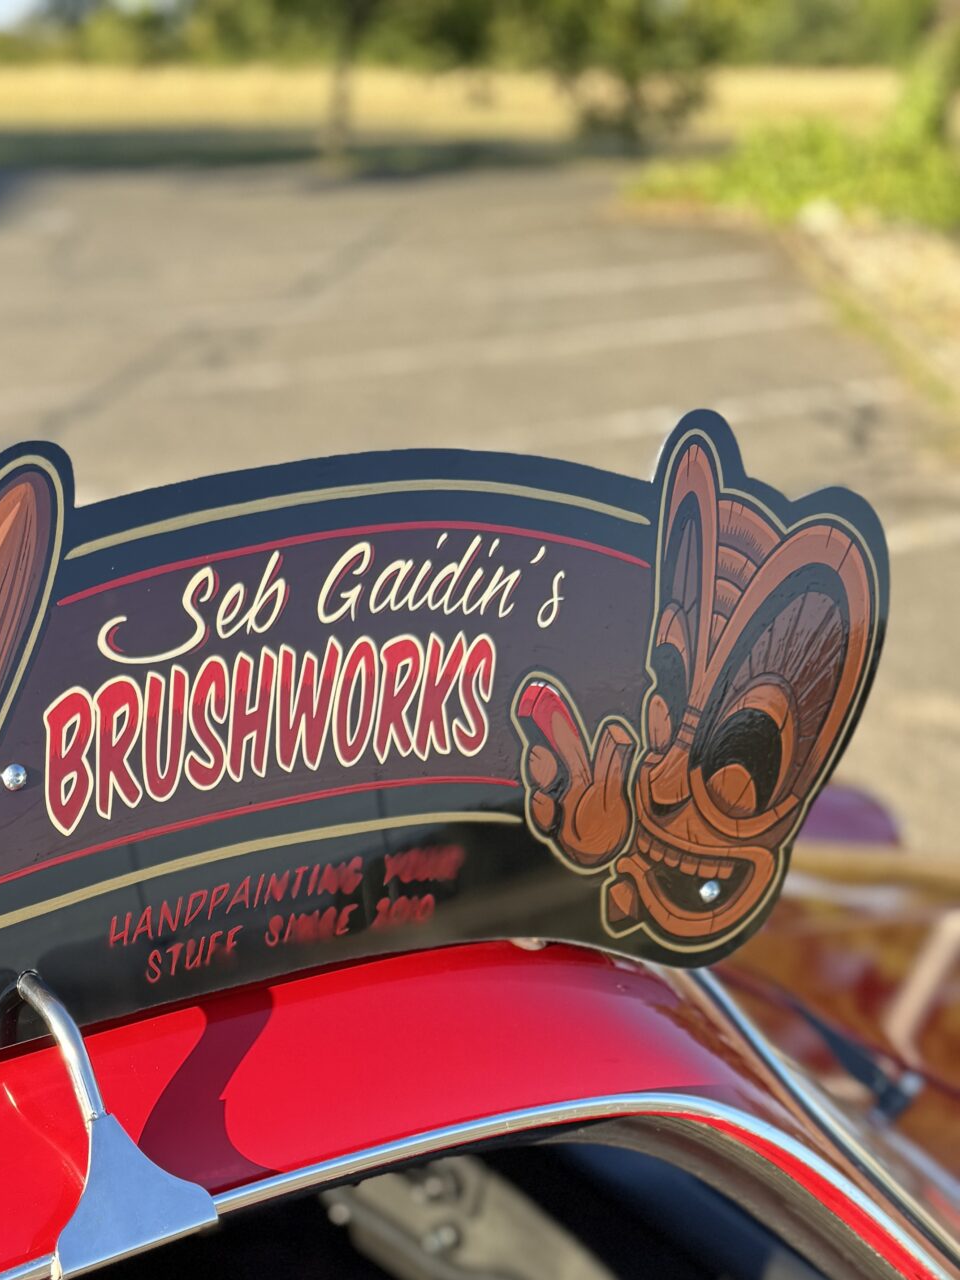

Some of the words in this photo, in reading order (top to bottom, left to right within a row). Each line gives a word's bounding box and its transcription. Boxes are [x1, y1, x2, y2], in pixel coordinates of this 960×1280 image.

[97, 550, 288, 664] Seb
[317, 532, 566, 628] Gaidin's
[43, 630, 496, 836] BRUSHWORKS
[109, 856, 364, 948] HANDPAINTING
[146, 924, 244, 984] STUFF
